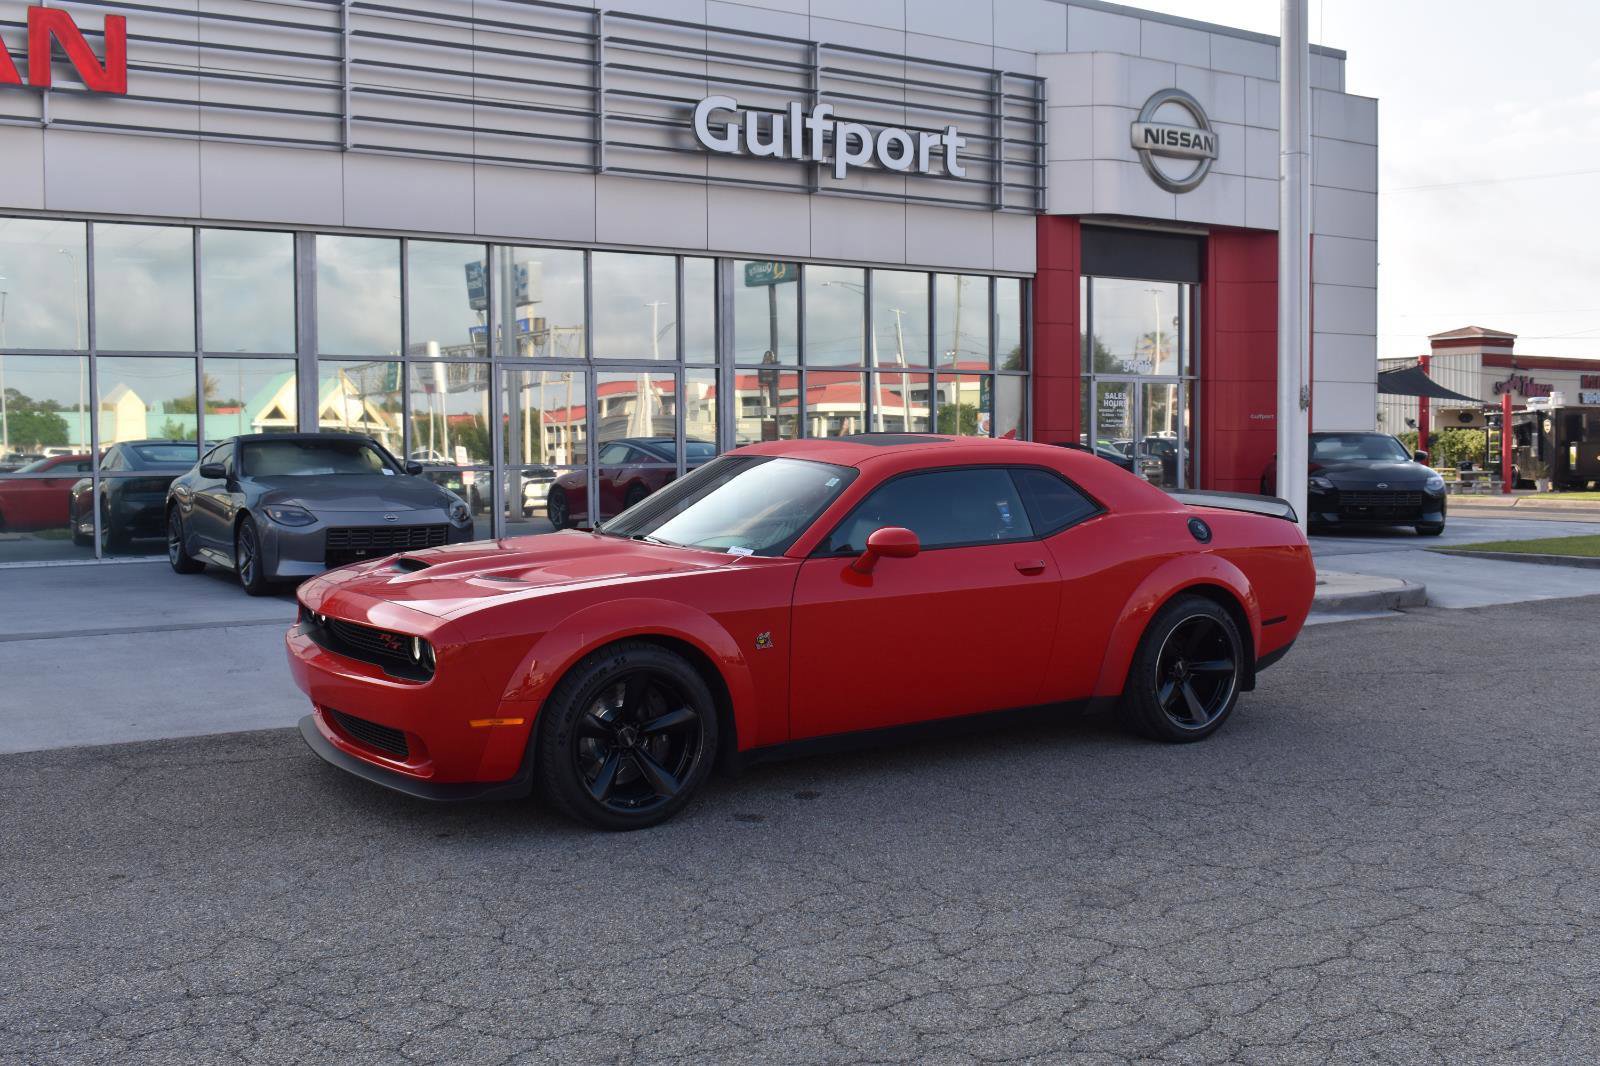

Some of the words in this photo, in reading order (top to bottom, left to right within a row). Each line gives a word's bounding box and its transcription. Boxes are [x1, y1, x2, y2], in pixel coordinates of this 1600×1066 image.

[692, 94, 967, 180] Gulfport
[1143, 126, 1215, 154] NISSAN
[1103, 399, 1128, 407] HOURS
